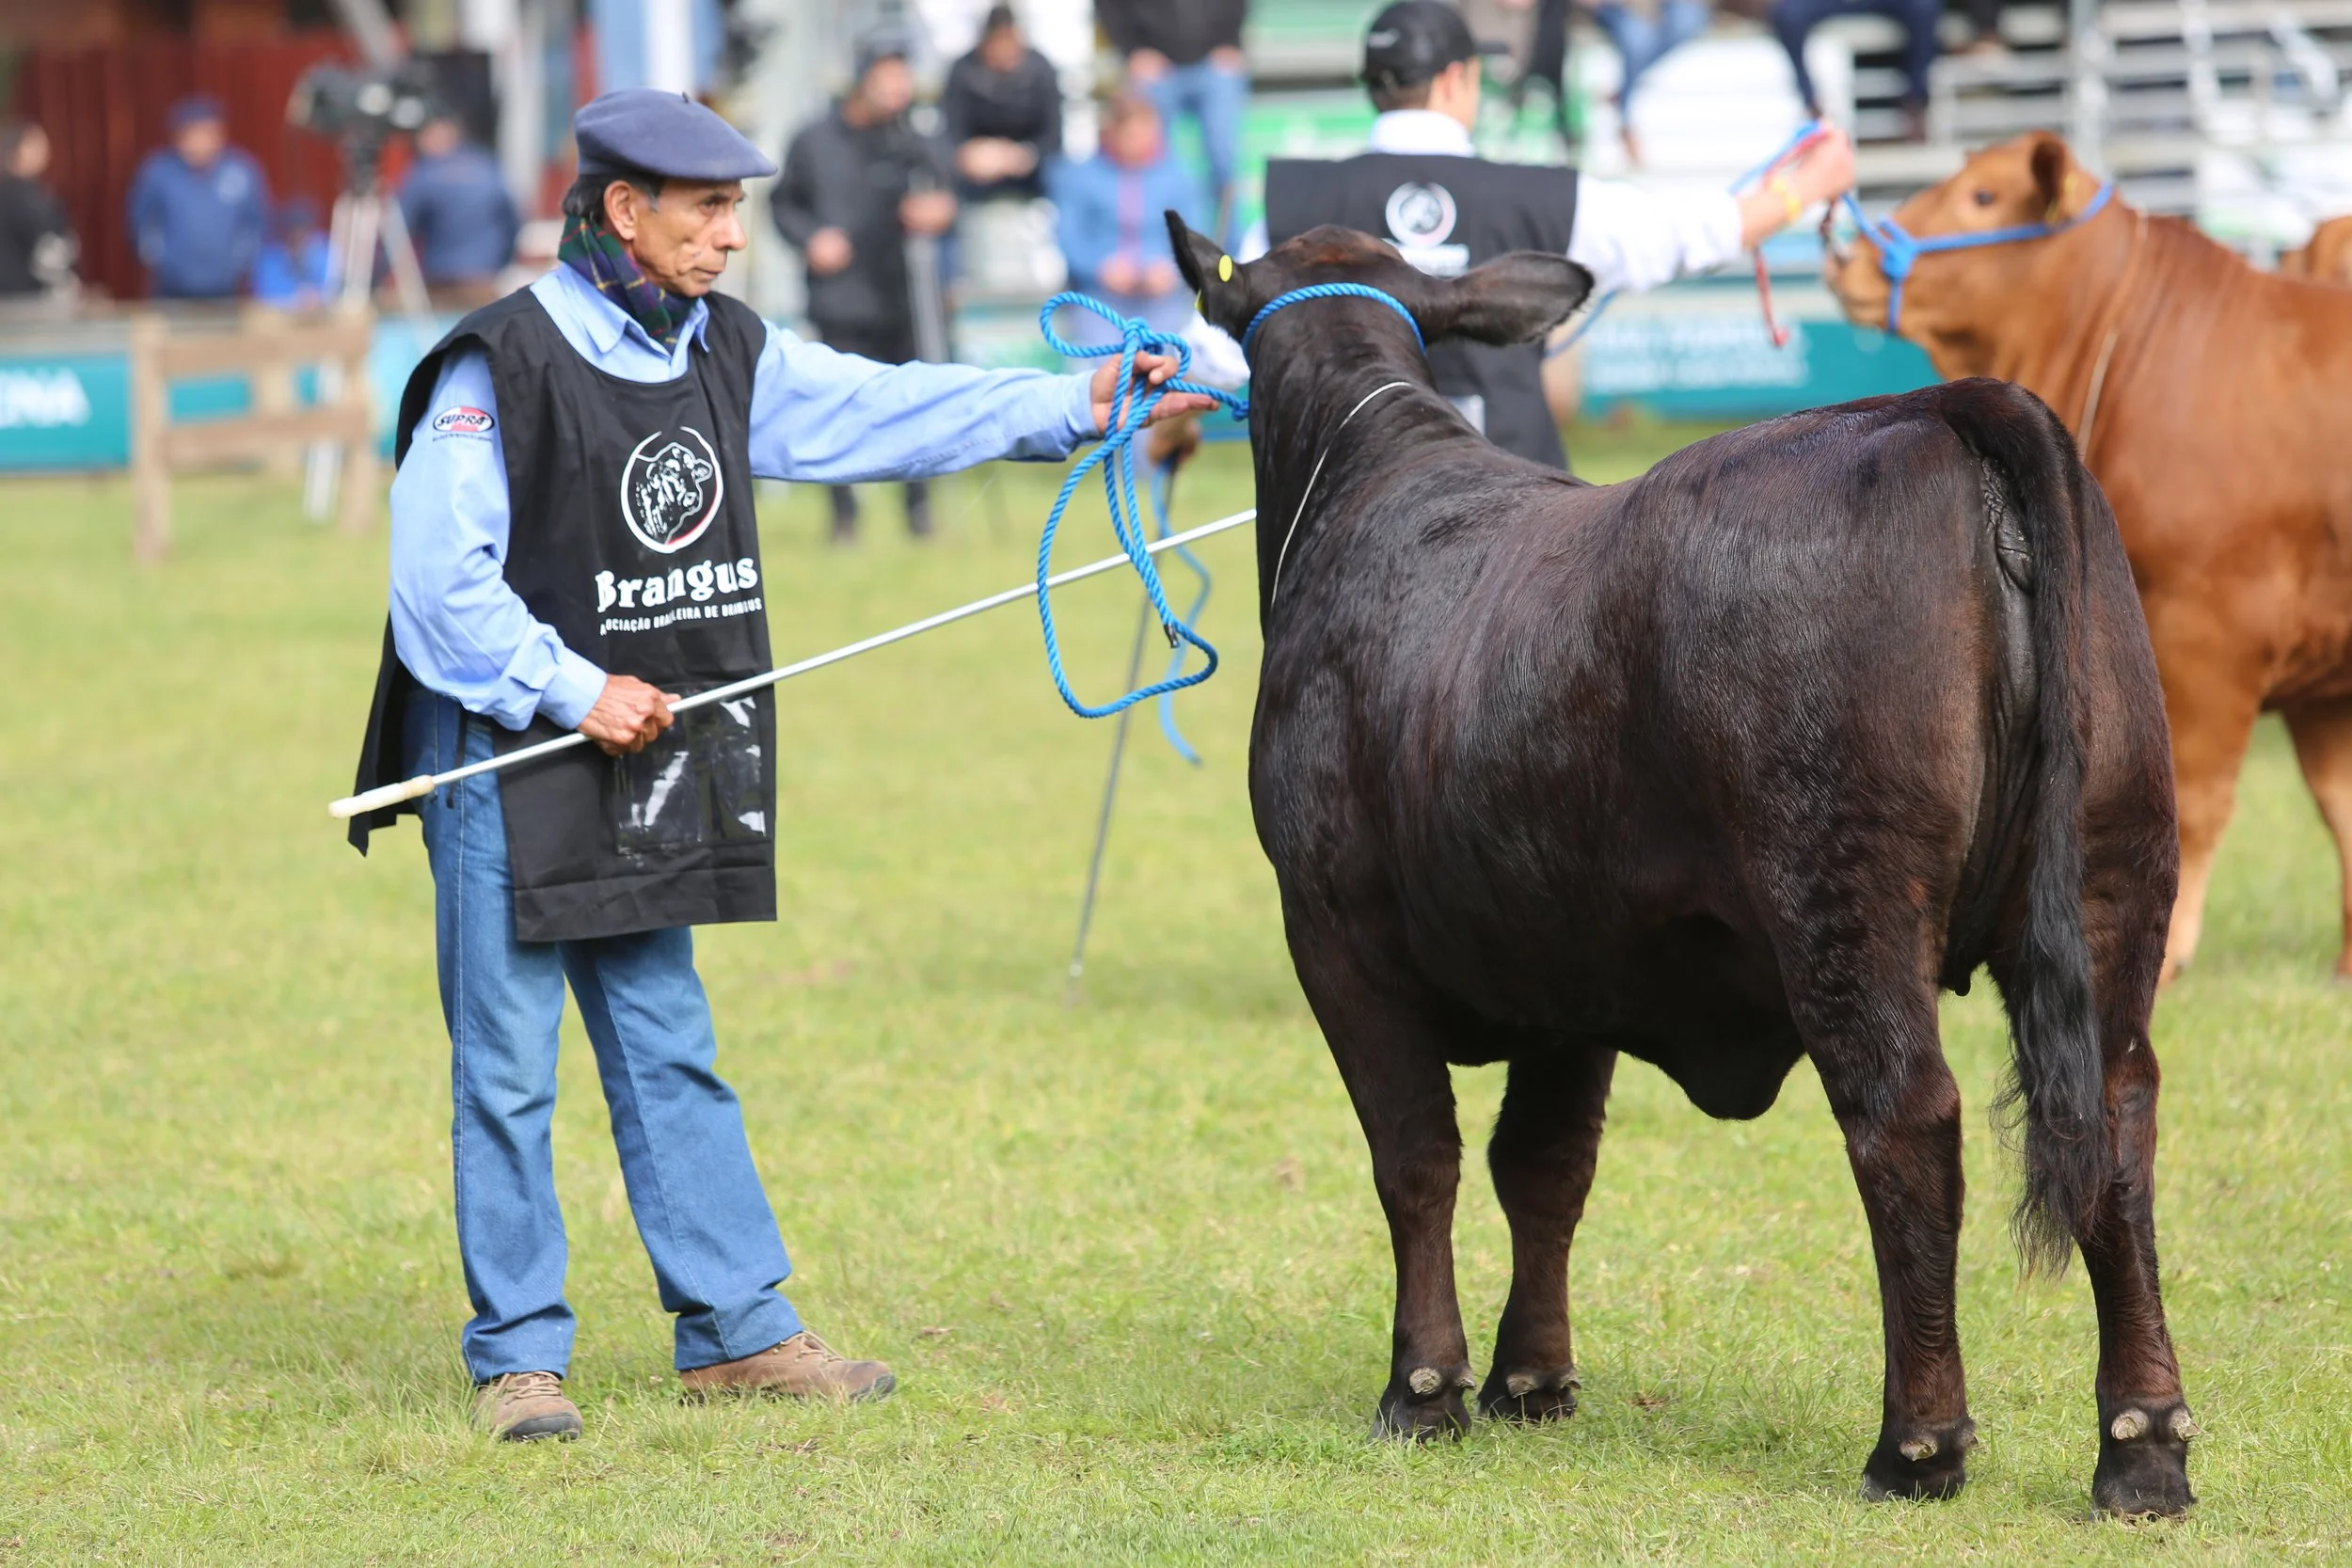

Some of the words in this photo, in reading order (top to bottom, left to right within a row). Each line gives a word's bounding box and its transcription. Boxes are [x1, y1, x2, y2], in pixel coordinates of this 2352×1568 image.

[437, 414, 487, 427] SUPRA
[596, 558, 758, 613] Brangus
[704, 605, 719, 619] DE
